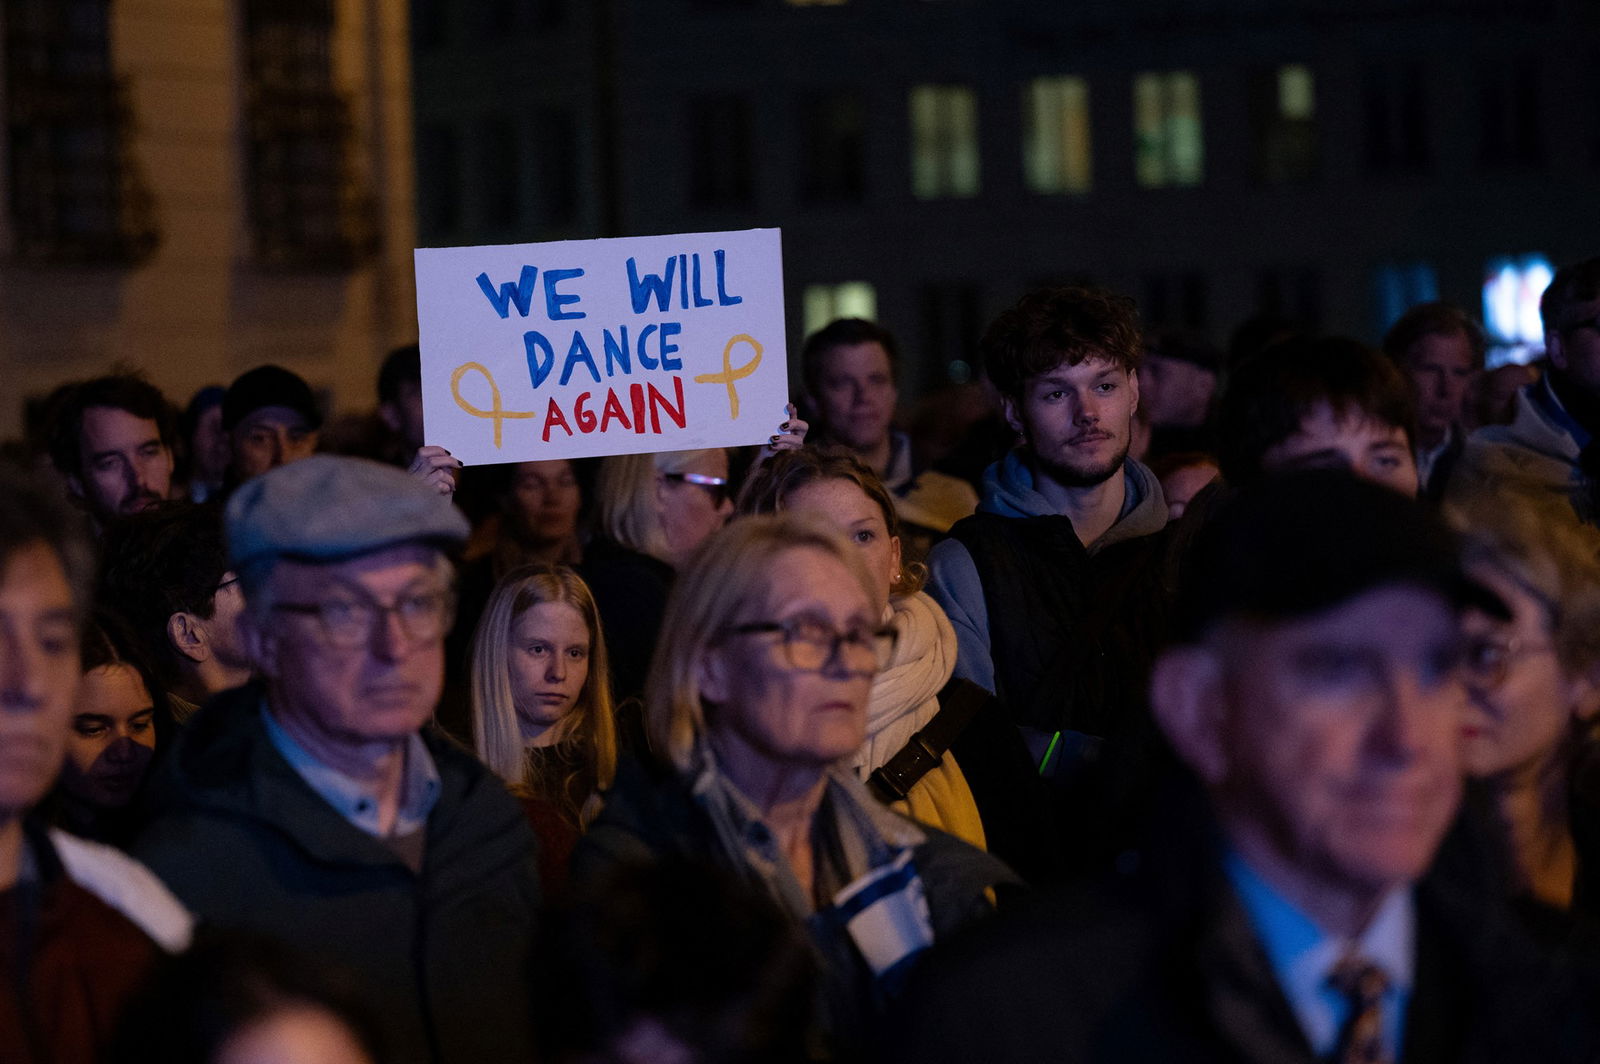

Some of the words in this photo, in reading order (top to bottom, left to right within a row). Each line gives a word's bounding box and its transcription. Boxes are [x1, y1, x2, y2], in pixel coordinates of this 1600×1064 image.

[476, 264, 586, 320] WE
[626, 249, 742, 314] WILL
[523, 322, 682, 389] DANCE
[542, 376, 686, 442] AGAIN
